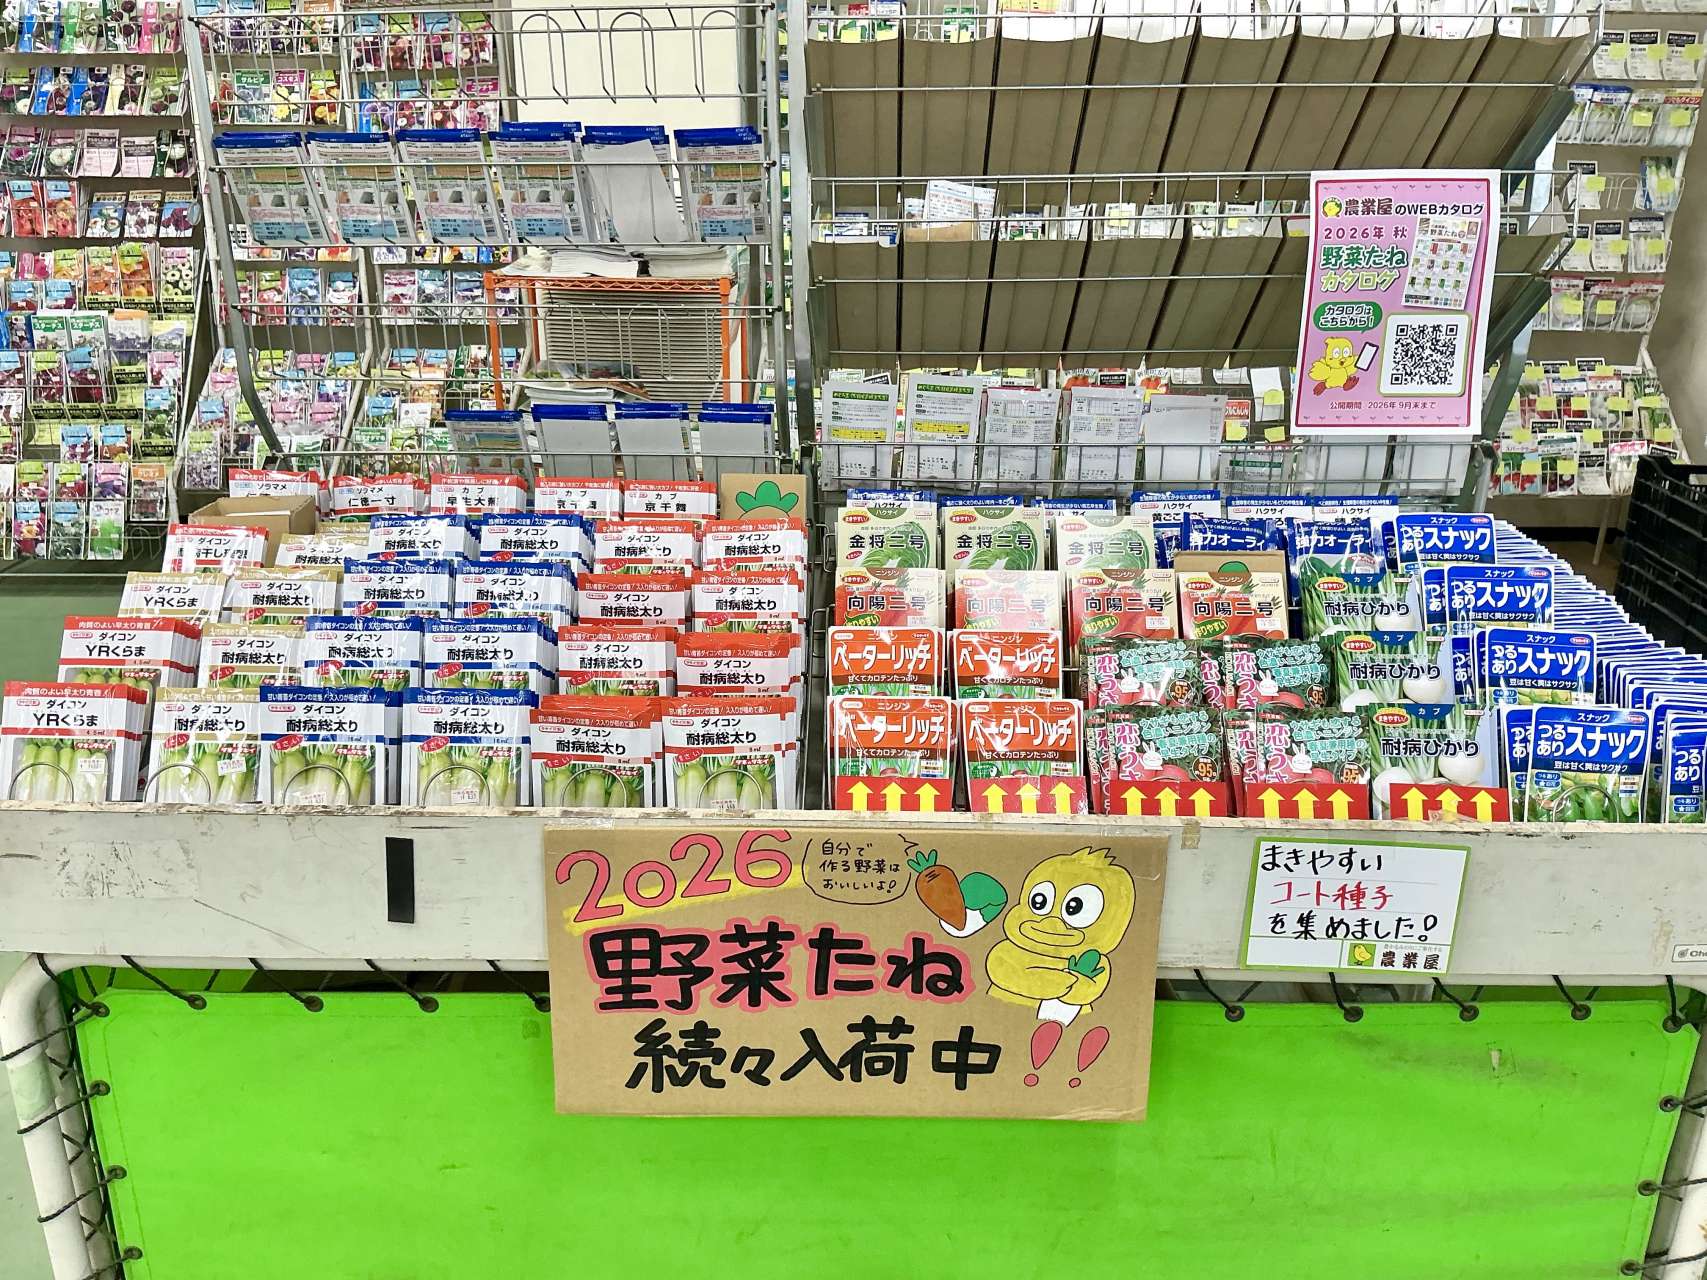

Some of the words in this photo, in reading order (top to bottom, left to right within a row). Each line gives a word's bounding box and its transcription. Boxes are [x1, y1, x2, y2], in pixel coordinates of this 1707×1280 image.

[1323, 226, 1384, 240] 2026年
[1393, 226, 1408, 240] 秋
[1321, 244, 1409, 268] 野菜たね
[1321, 270, 1401, 292] カタログ
[1325, 304, 1372, 316] カタログは
[257, 483, 287, 491] ソラマメ
[348, 496, 397, 507] 仁徳一寸
[655, 492, 678, 500] カブ
[645, 502, 688, 513] 京千舞
[1255, 507, 1284, 515] ハクサイ
[1341, 507, 1371, 515] ハクサイ
[513, 528, 548, 536] ダイコン
[627, 534, 660, 542] ダイコン
[737, 533, 769, 542] ダイコン
[198, 537, 231, 545] ダイコン
[500, 539, 559, 550] 耐病総太り
[850, 534, 925, 550] 金将二号
[957, 534, 1033, 550] 金将二号
[1424, 527, 1491, 551] スナック
[724, 545, 781, 556] 耐病総太り
[1067, 541, 1144, 557] 金将二号
[1354, 576, 1373, 584] カブ
[1484, 570, 1515, 578] スナック
[266, 582, 302, 591] ダイコン
[490, 578, 526, 586] ダイコン
[156, 586, 190, 594] ダイコン
[363, 588, 426, 600] 耐病総太り
[1476, 582, 1549, 608] スナック
[144, 596, 199, 607] YRくらま
[253, 594, 313, 606] 耐病総太り
[613, 593, 650, 602] ダイコン
[848, 595, 928, 611] 向陽二号
[716, 599, 777, 611] 耐病総太り
[1085, 597, 1165, 613] 向陽二号
[1194, 601, 1274, 617] 向陽二号
[1325, 601, 1410, 617] 耐病ひかり
[600, 606, 663, 617] 耐病総太り
[98, 632, 137, 641] ダイコン
[343, 633, 382, 642] ダイコン
[462, 634, 500, 644] ダイコン
[1383, 634, 1405, 642] カブ
[1526, 634, 1556, 643] スナック
[236, 639, 275, 648] ダイコン
[593, 643, 630, 653] ダイコン
[85, 644, 146, 657] YRくらま
[447, 648, 514, 661] 耐病総太り
[221, 652, 287, 664] 耐病総太り
[579, 656, 644, 670] 耐病総太り
[713, 659, 752, 669] ダイコン
[1518, 646, 1591, 676] スナック
[1350, 663, 1441, 681] 耐病ひかり
[699, 672, 766, 685] 耐病総太り
[302, 704, 346, 715] ダイコン
[449, 706, 490, 717] ダイコン
[1418, 708, 1441, 716] カブ
[32, 713, 99, 727] YRくらま
[700, 718, 741, 728] ダイコン
[1577, 713, 1610, 722] スナック
[286, 718, 359, 733] 耐病総太り
[433, 720, 505, 735] 耐病総太り
[837, 714, 945, 744] ベーターリッチ
[571, 727, 612, 738] ダイコン
[686, 731, 757, 746] 耐病総太り
[556, 739, 626, 756] 耐病総太り
[1381, 739, 1479, 757] 耐病ひかり
[1565, 726, 1646, 759] スナック
[1675, 749, 1701, 764] つる
[1674, 766, 1700, 781] あり
[819, 840, 875, 857] 自分で
[818, 856, 902, 875] 作る野菜は
[1260, 844, 1384, 875] まきやすい
[555, 829, 794, 923] 2026
[1270, 880, 1394, 911] コート種子
[1269, 910, 1438, 942] を集めました!
[1381, 950, 1440, 970] 農業屋
[590, 924, 967, 1012] 野菜たね
[625, 1015, 1002, 1093] 続々入荷中
